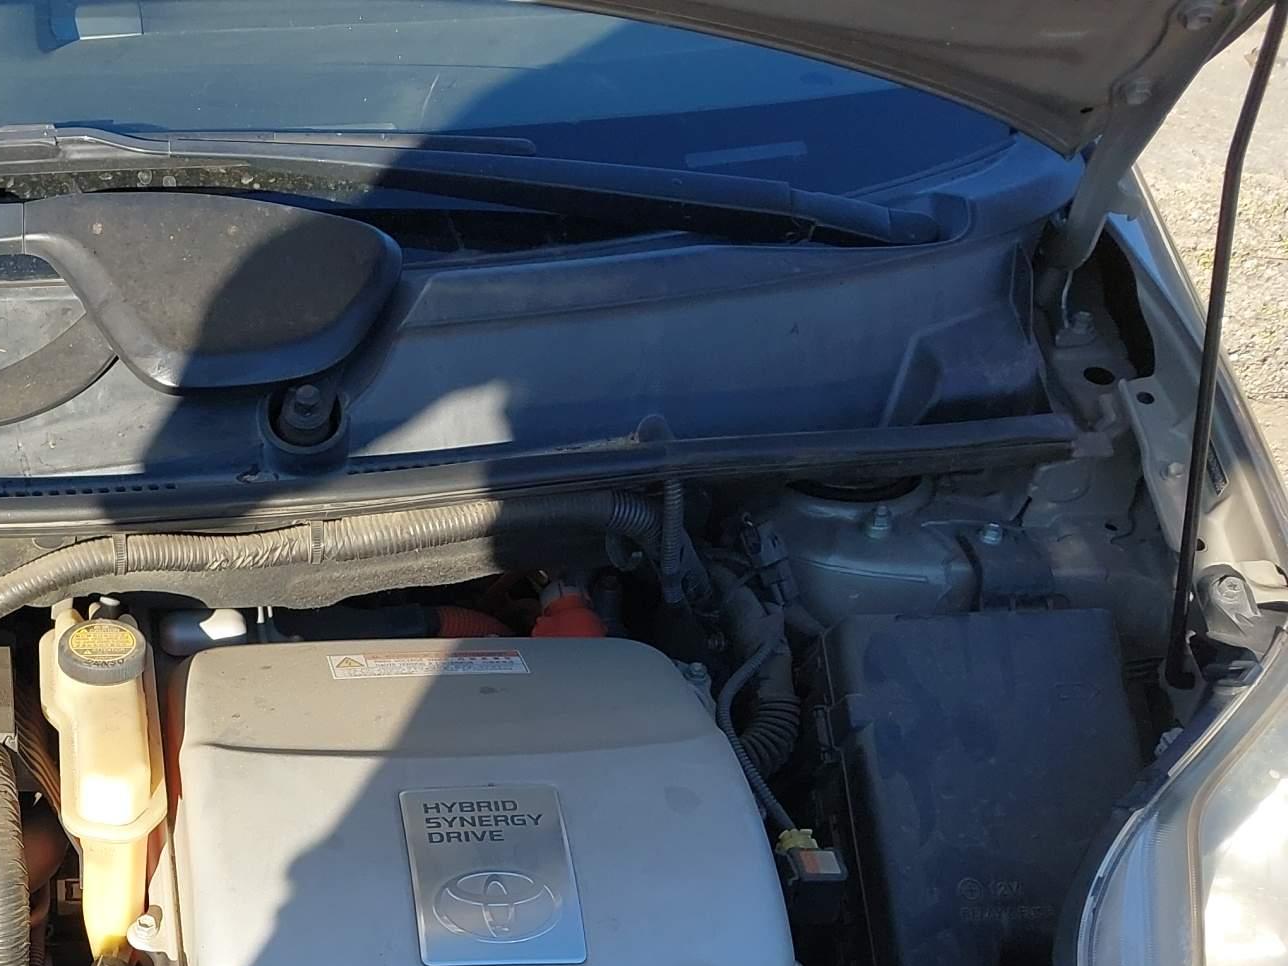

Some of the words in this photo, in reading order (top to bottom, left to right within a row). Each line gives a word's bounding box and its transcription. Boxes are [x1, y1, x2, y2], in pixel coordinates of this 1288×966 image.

[423, 800, 518, 814] HYBRID
[425, 814, 543, 829] SYNERGY
[427, 830, 504, 843] DRIVE
